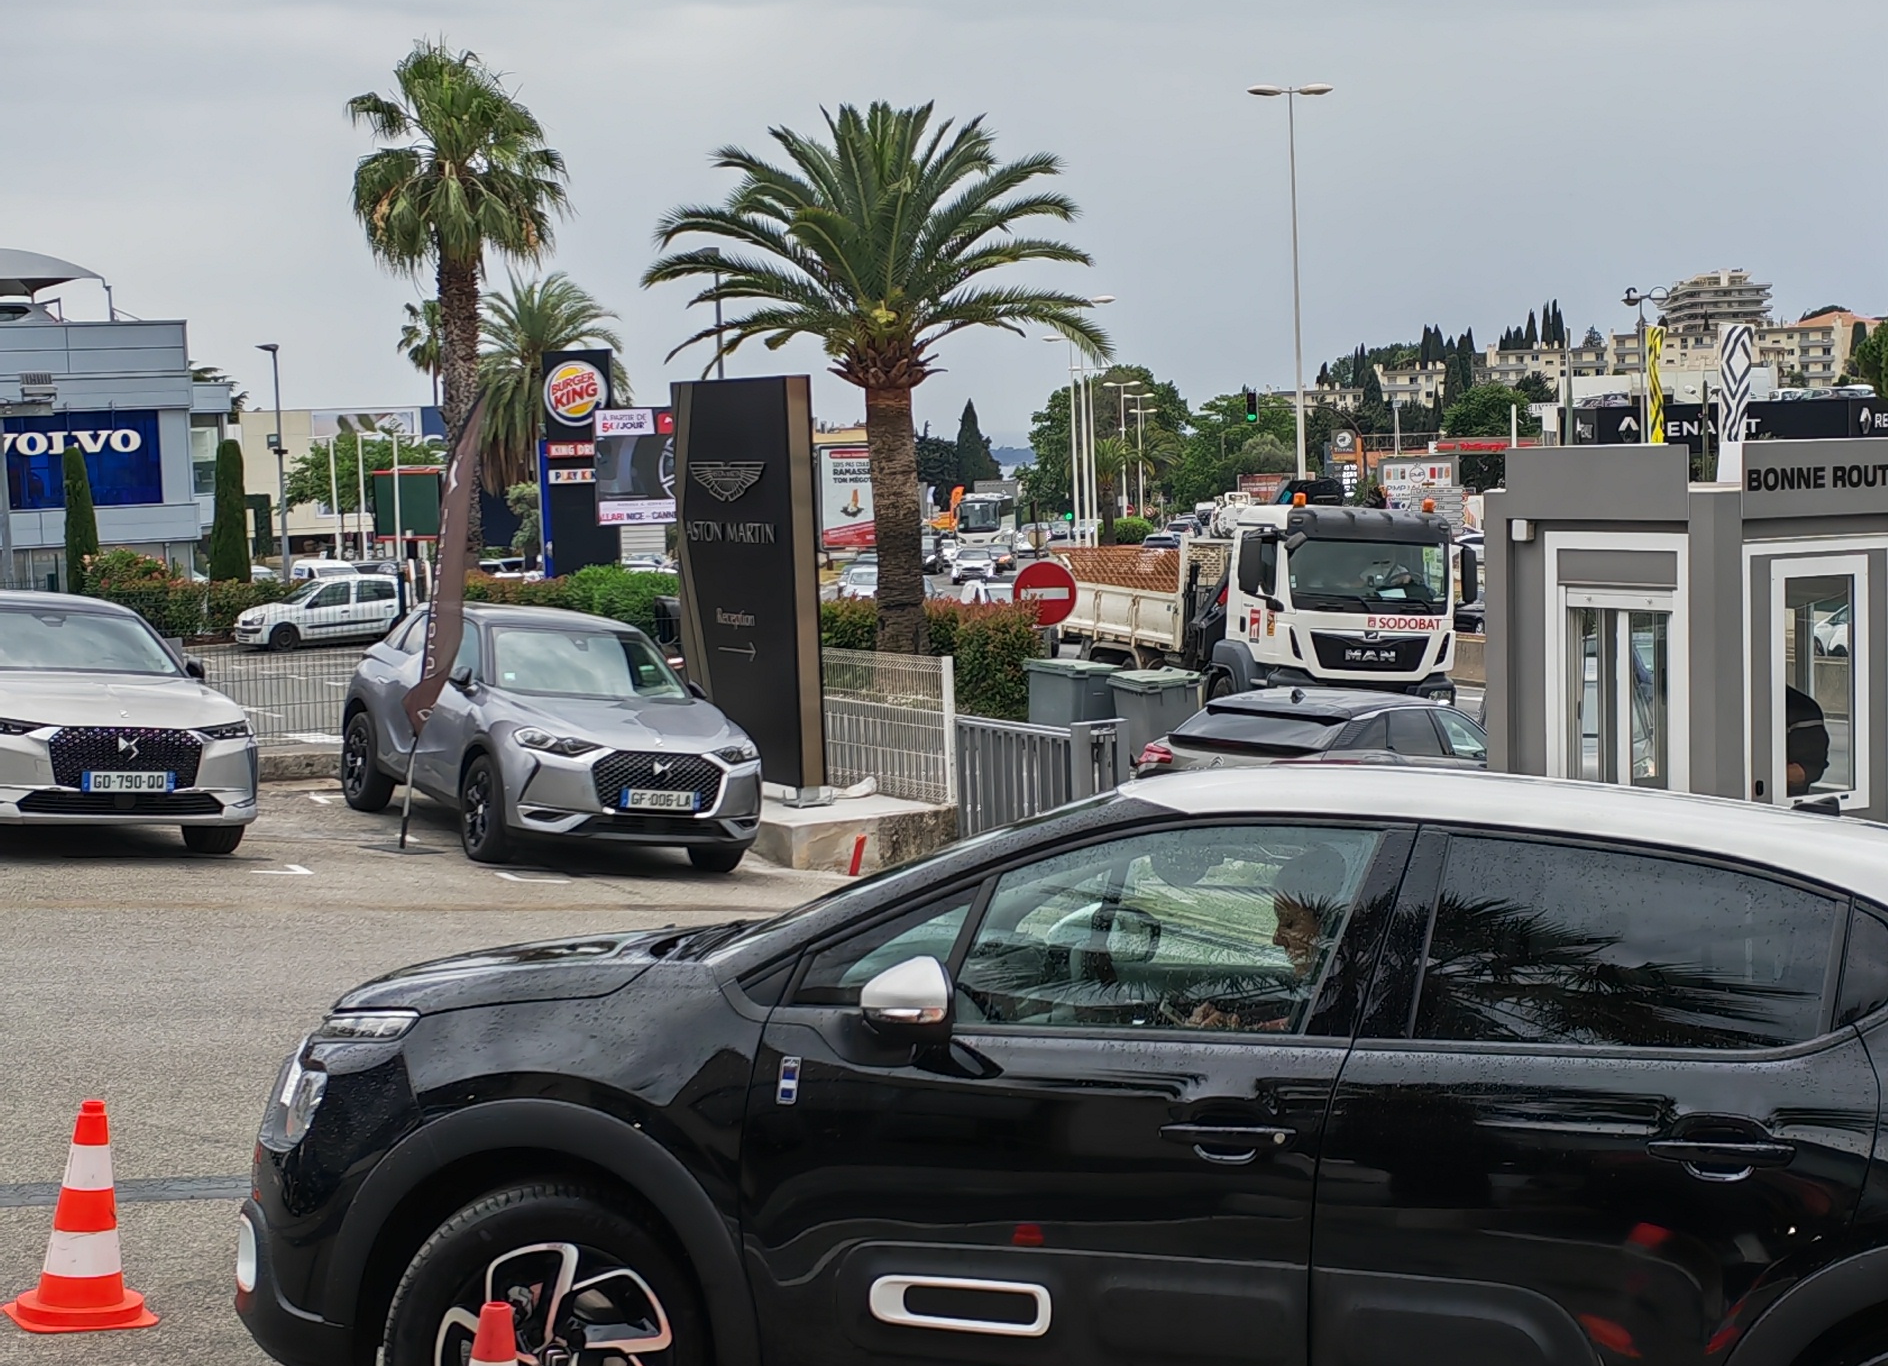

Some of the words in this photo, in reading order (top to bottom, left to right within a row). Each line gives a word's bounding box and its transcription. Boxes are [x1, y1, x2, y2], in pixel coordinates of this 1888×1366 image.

[551, 371, 596, 396] BURGER
[553, 382, 598, 411] KING
[1663, 418, 1761, 437] ENAT
[1747, 466, 1826, 492] BONNE
[626, 512, 645, 521] NICE
[686, 520, 723, 542] ASTON
[725, 522, 776, 544] MARTIN
[715, 607, 756, 630] Reception
[1378, 617, 1442, 631] SODOBAT
[1344, 648, 1396, 663] MAN
